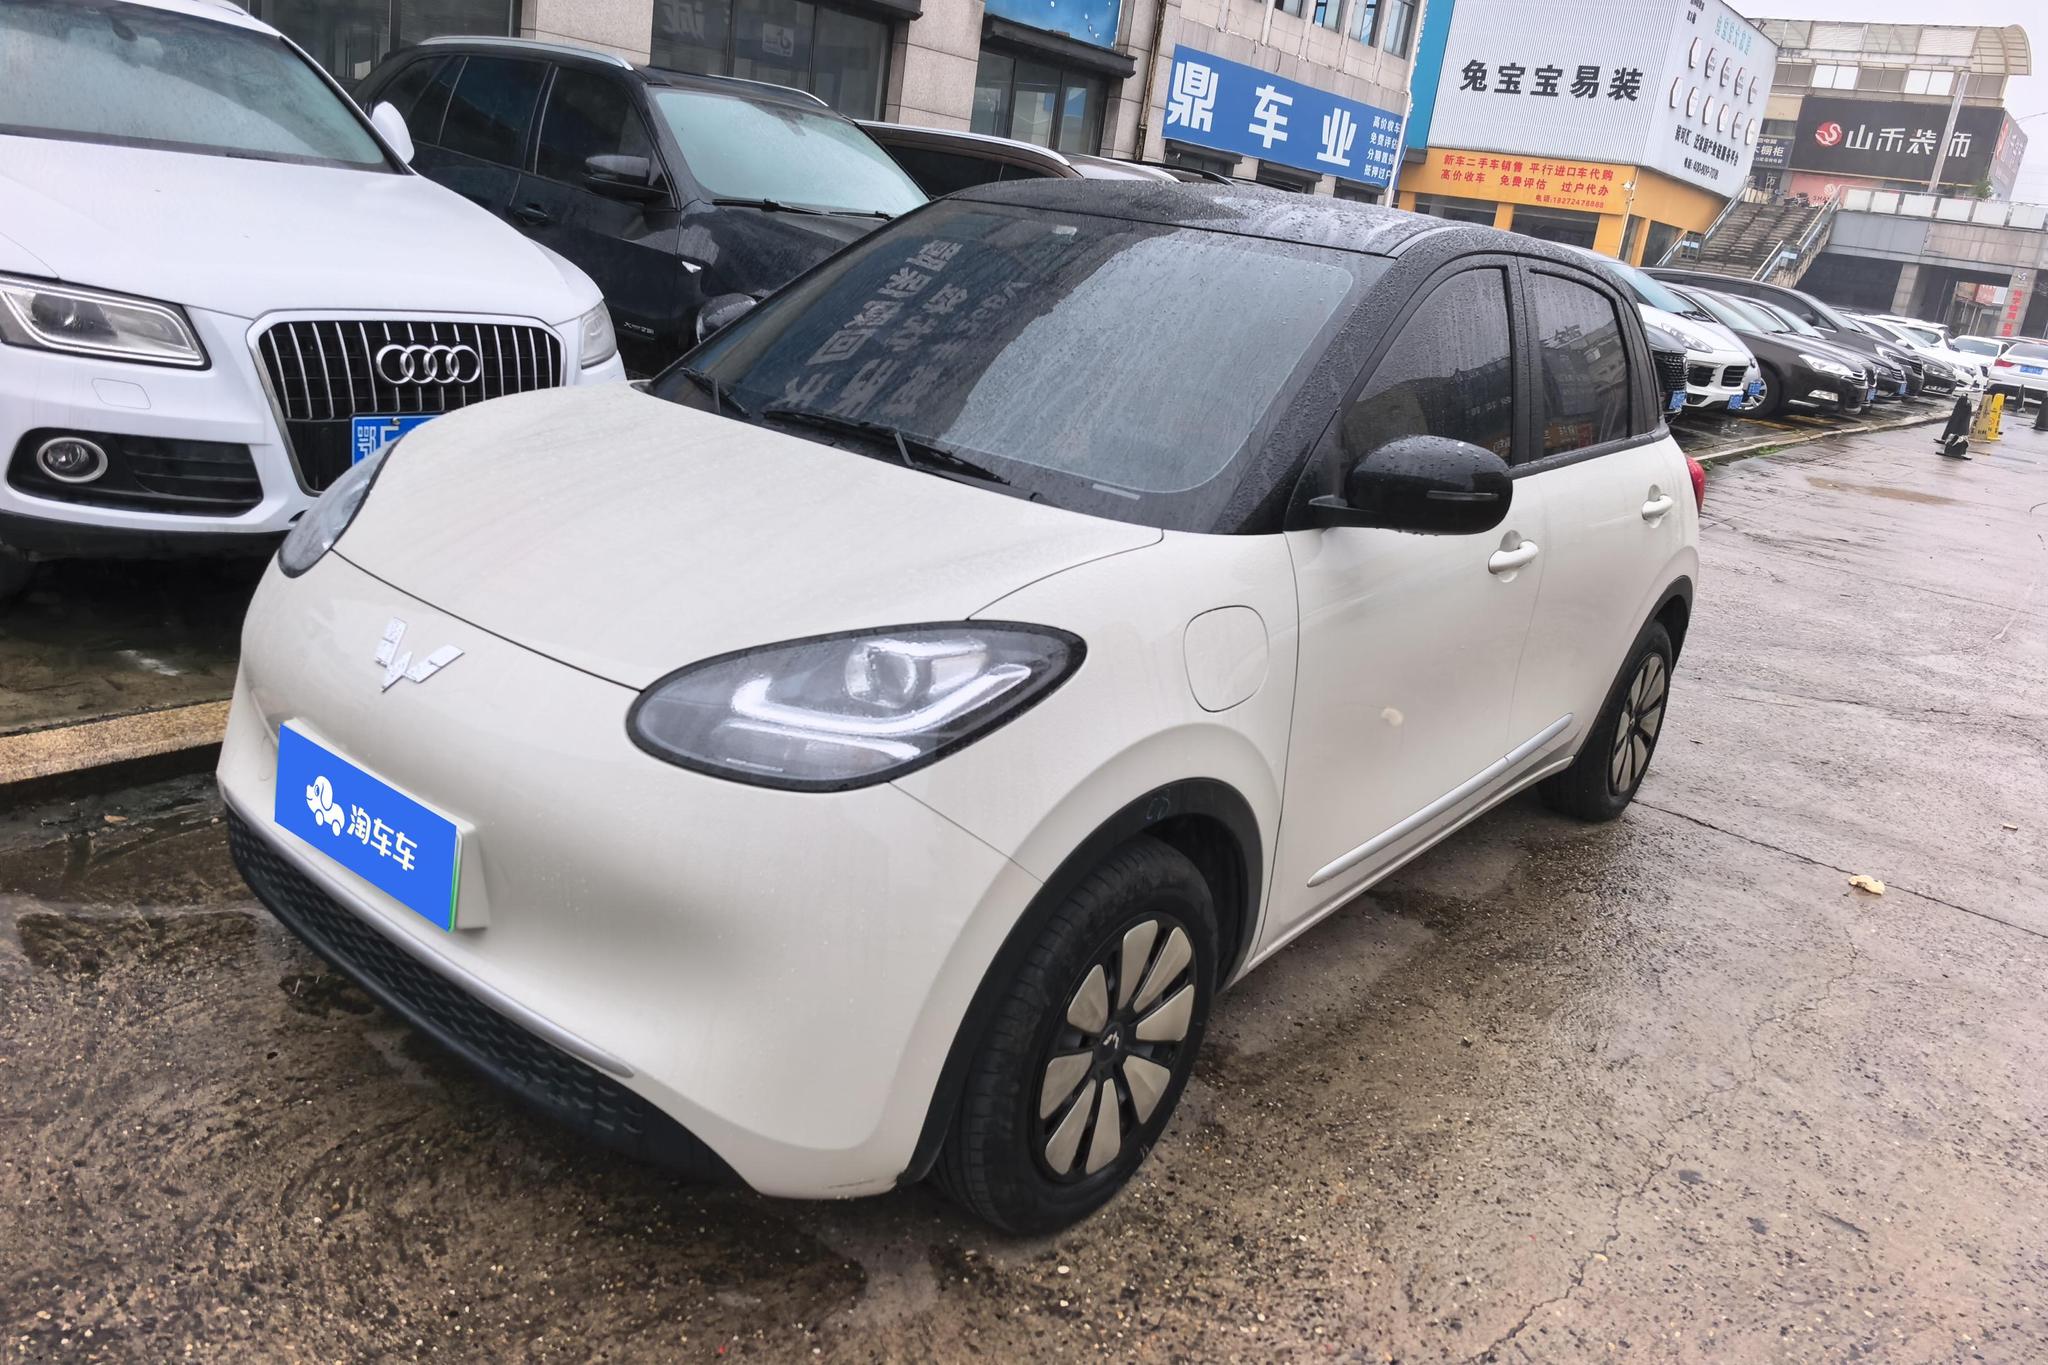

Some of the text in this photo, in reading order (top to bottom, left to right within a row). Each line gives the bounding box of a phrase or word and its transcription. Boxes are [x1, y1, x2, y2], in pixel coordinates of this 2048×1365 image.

[1459, 59, 1644, 102] 兔宝宝易装
[1167, 61, 1357, 168] 鼎车业
[1372, 115, 1401, 134] 高价收车
[1440, 168, 1610, 197] 高价收车 免费评估 过户代办
[1443, 154, 1614, 182] 新车二手车销售 平行进口车代购
